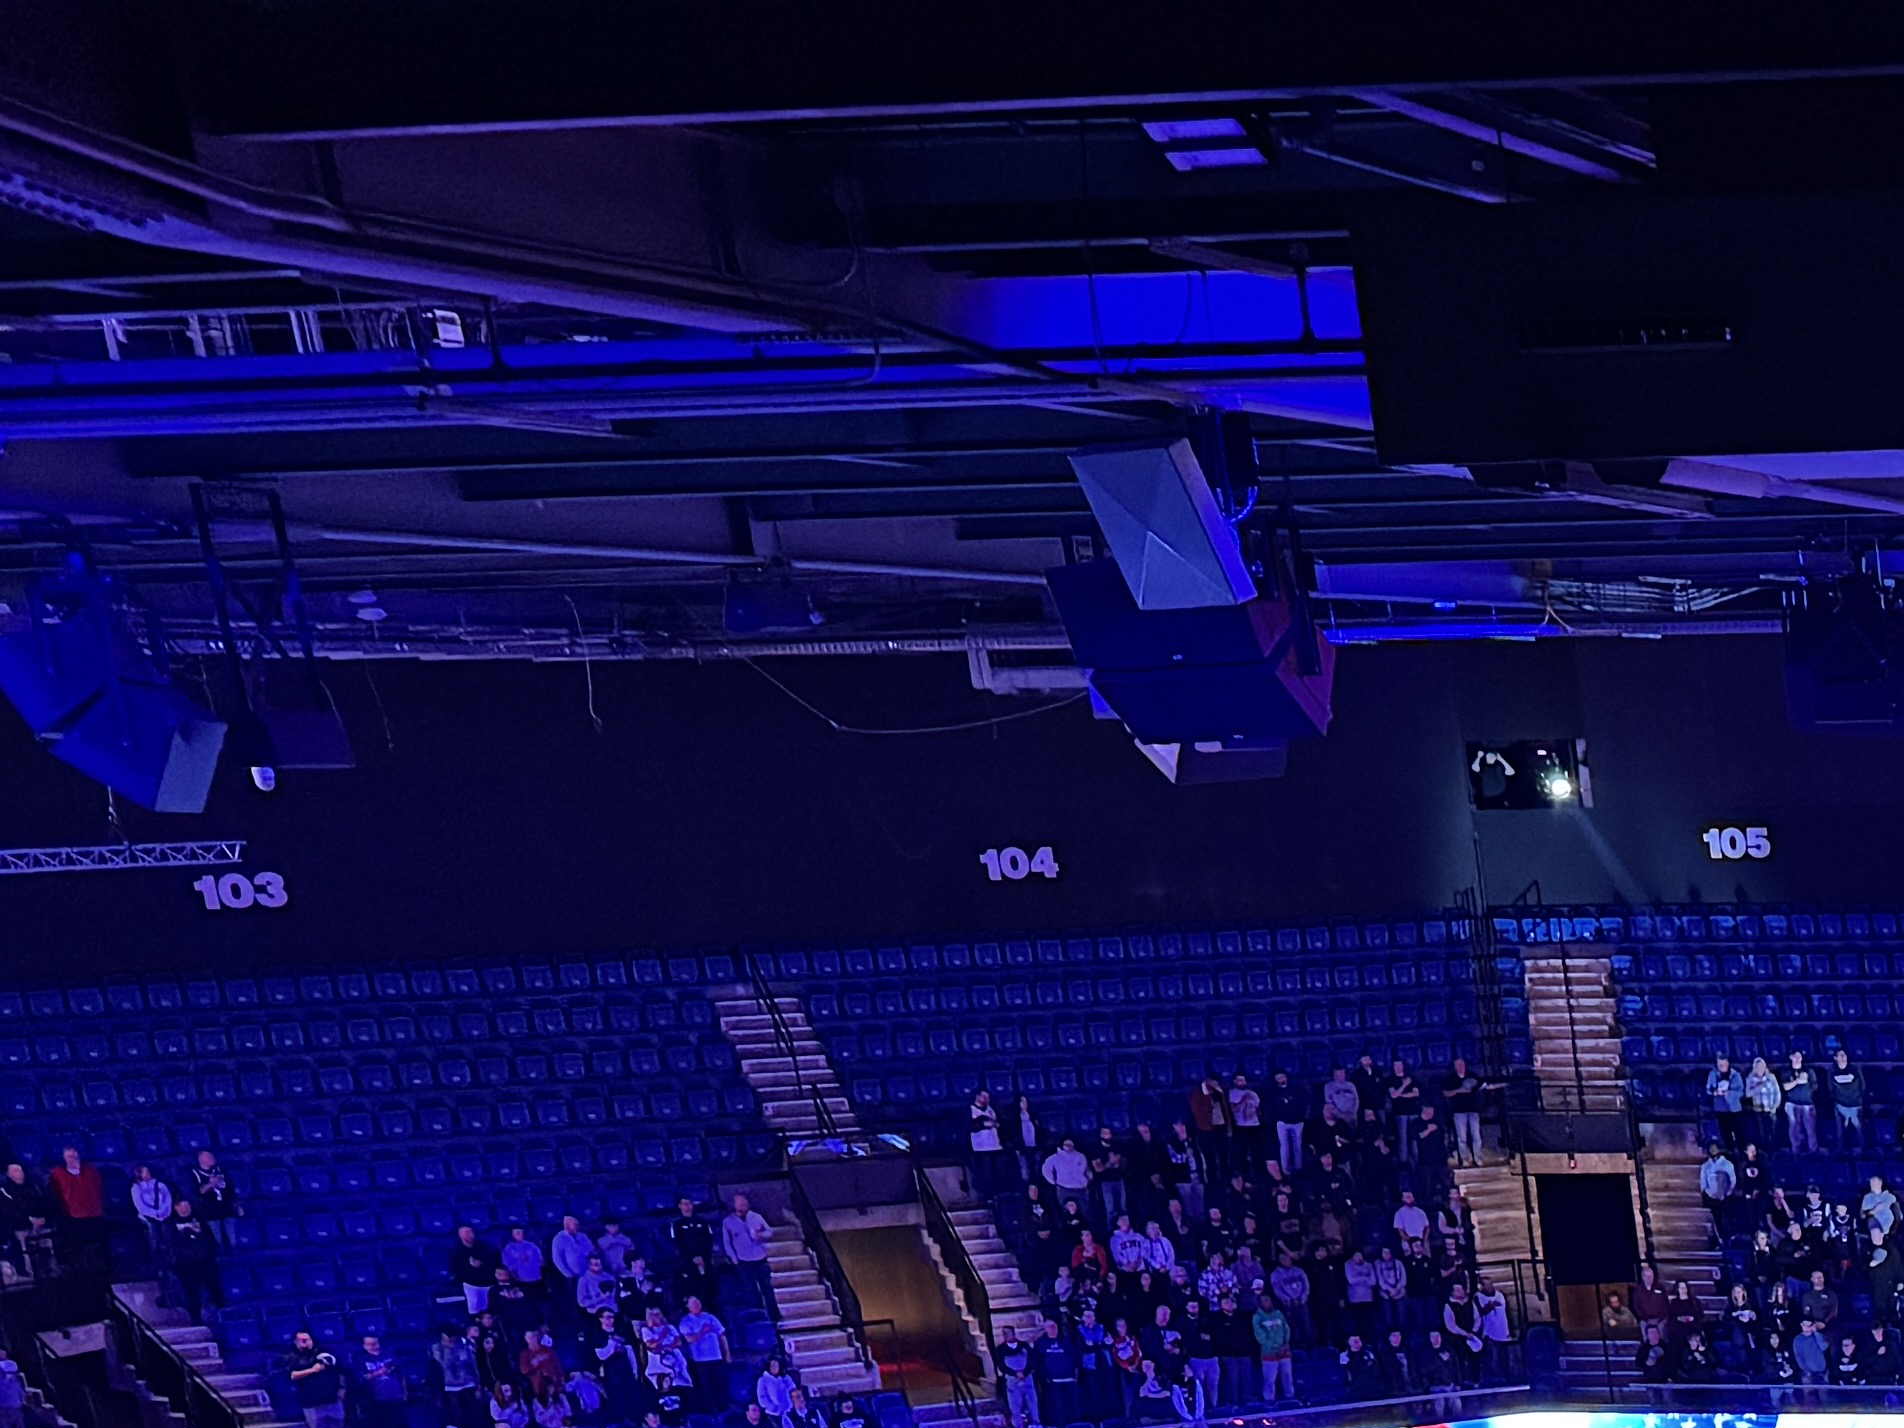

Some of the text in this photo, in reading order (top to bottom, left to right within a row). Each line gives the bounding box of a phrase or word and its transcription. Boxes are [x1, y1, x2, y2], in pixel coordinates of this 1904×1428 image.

[1703, 827, 1771, 860] 105
[980, 846, 1059, 881] 104
[194, 872, 288, 909] 103
